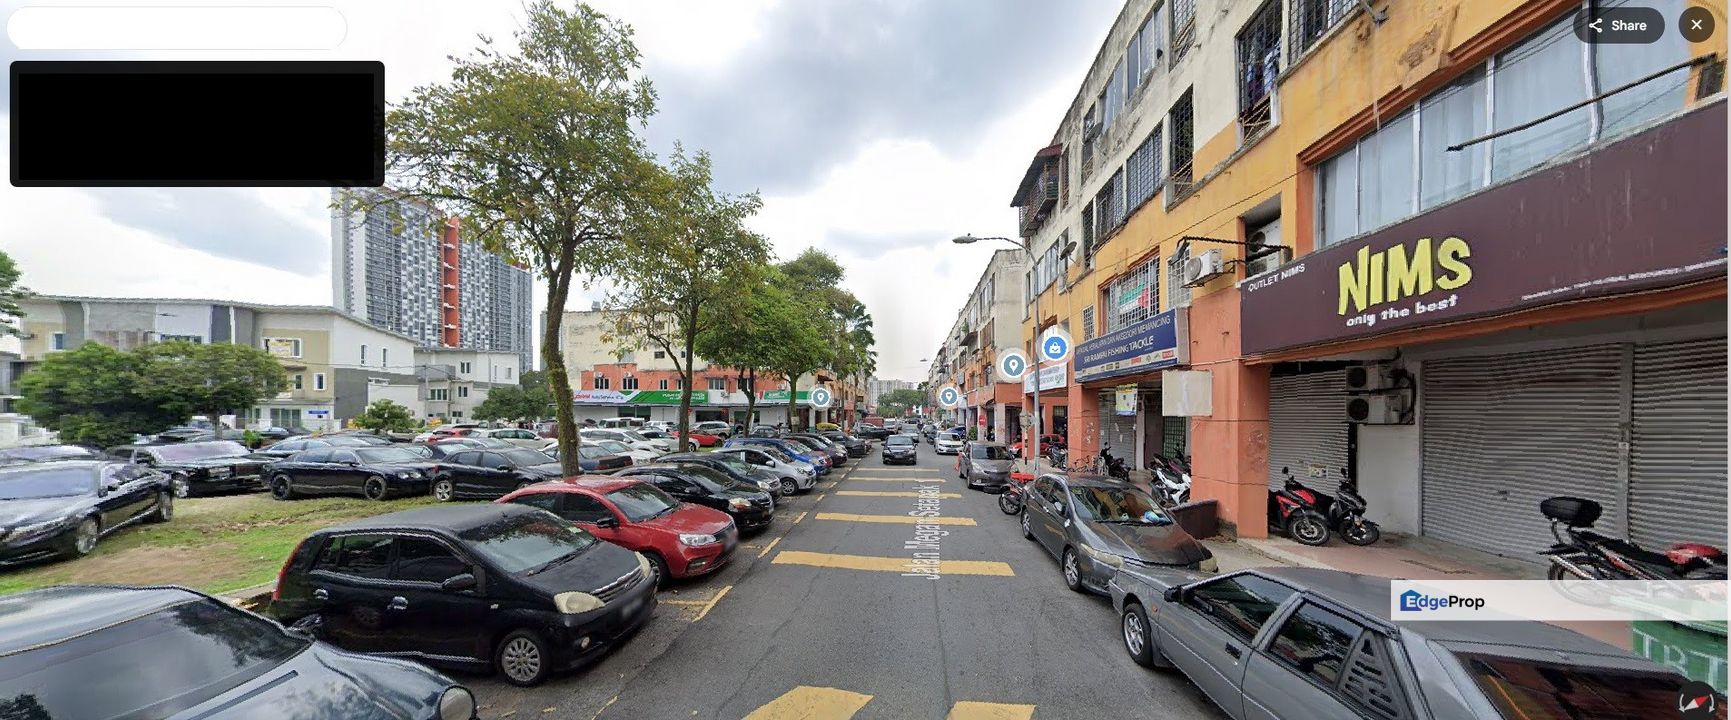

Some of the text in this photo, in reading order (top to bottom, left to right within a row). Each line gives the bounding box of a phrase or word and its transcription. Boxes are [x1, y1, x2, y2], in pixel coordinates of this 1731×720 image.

[1248, 263, 1305, 292] OUTLET NIMS
[1338, 237, 1473, 316] NIMS
[1346, 294, 1459, 327] only the best
[1108, 345, 1129, 357] FISHING
[1129, 335, 1154, 351] TACKLE
